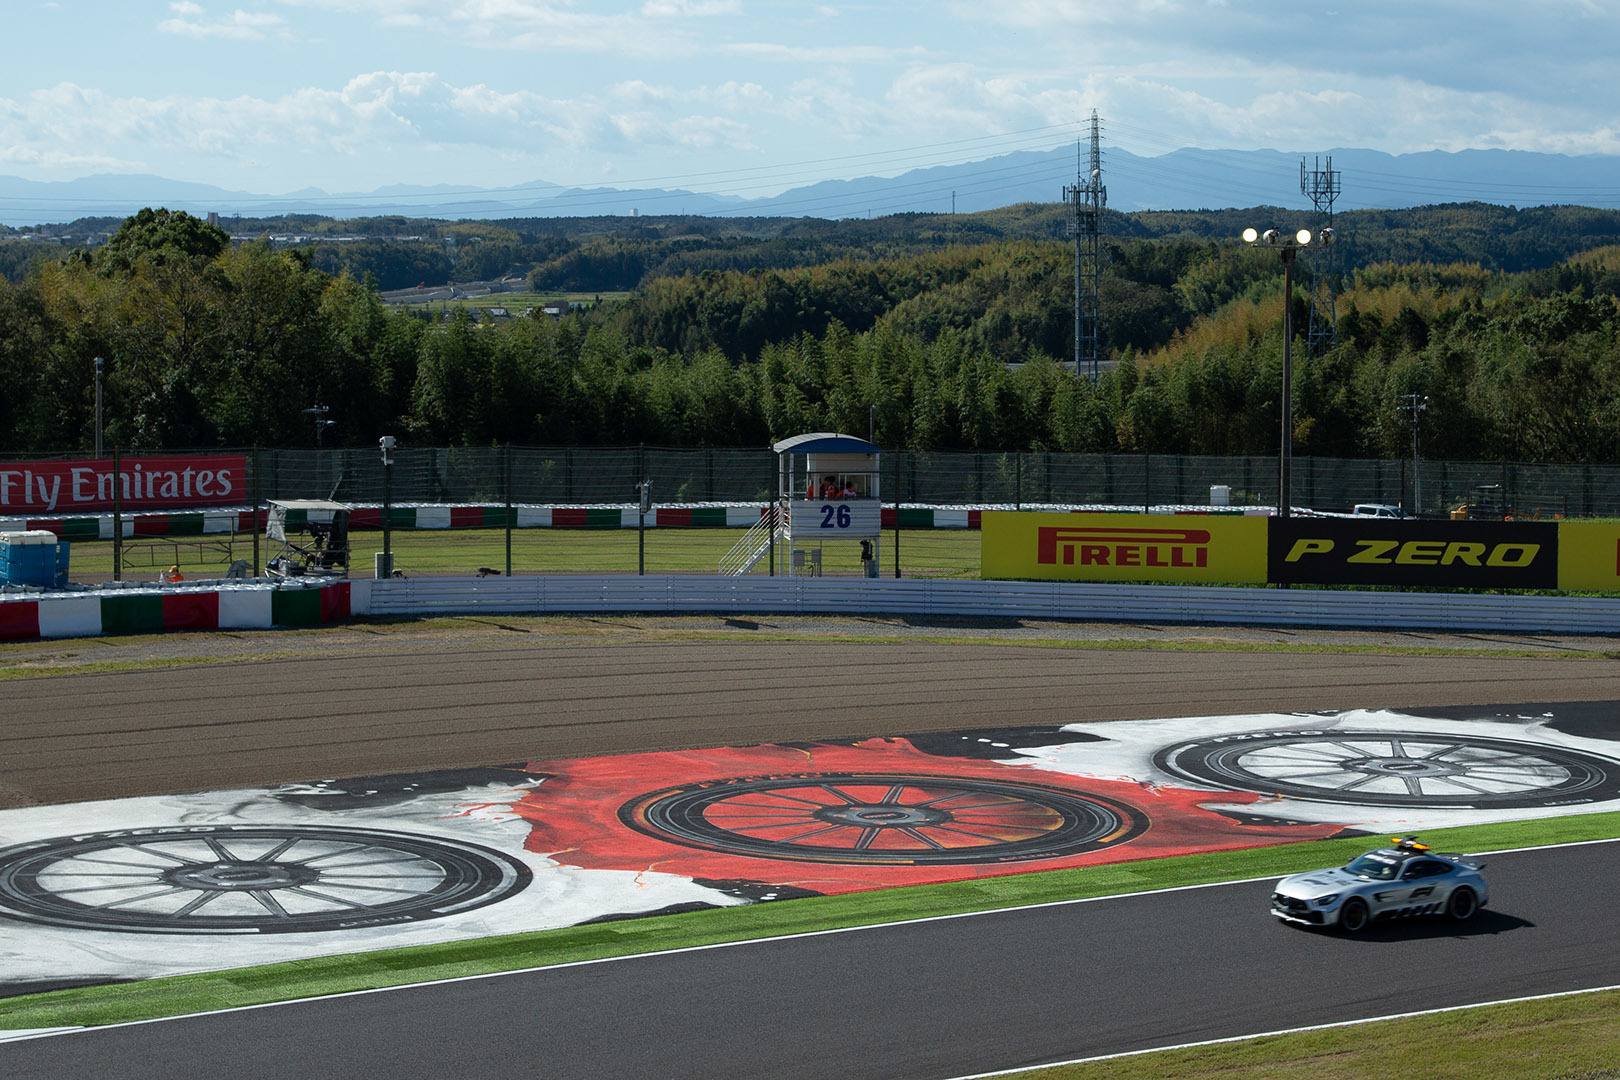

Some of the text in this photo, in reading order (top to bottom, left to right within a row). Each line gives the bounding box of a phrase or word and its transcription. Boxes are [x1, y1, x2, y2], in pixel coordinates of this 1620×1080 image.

[0, 463, 232, 510] Fly Emirates
[820, 504, 851, 529] 26
[1038, 527, 1211, 567] PIRELLI
[1284, 539, 1541, 567] P ZERO
